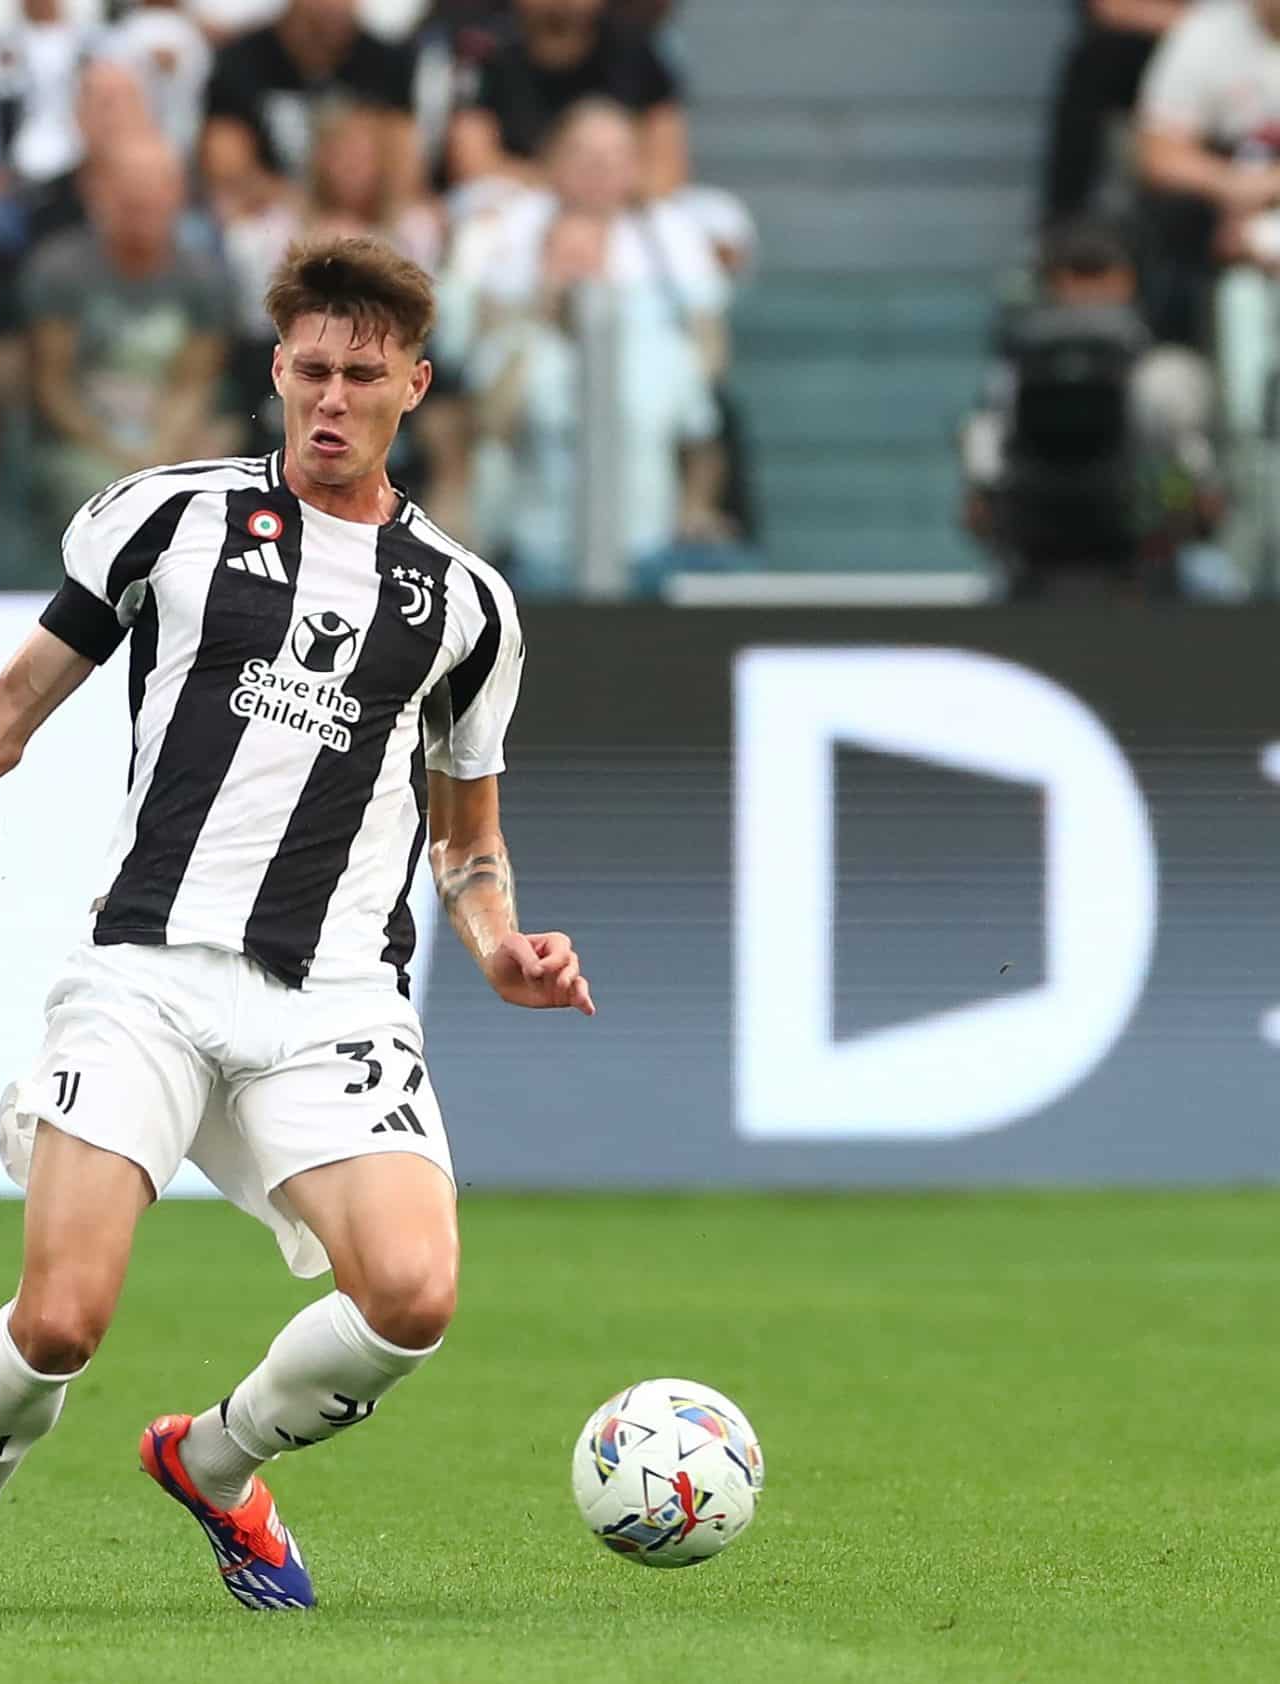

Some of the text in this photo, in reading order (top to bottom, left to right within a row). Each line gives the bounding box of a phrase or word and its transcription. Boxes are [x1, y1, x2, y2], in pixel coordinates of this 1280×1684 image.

[234, 689, 347, 748] Children
[243, 661, 357, 718] Save the
